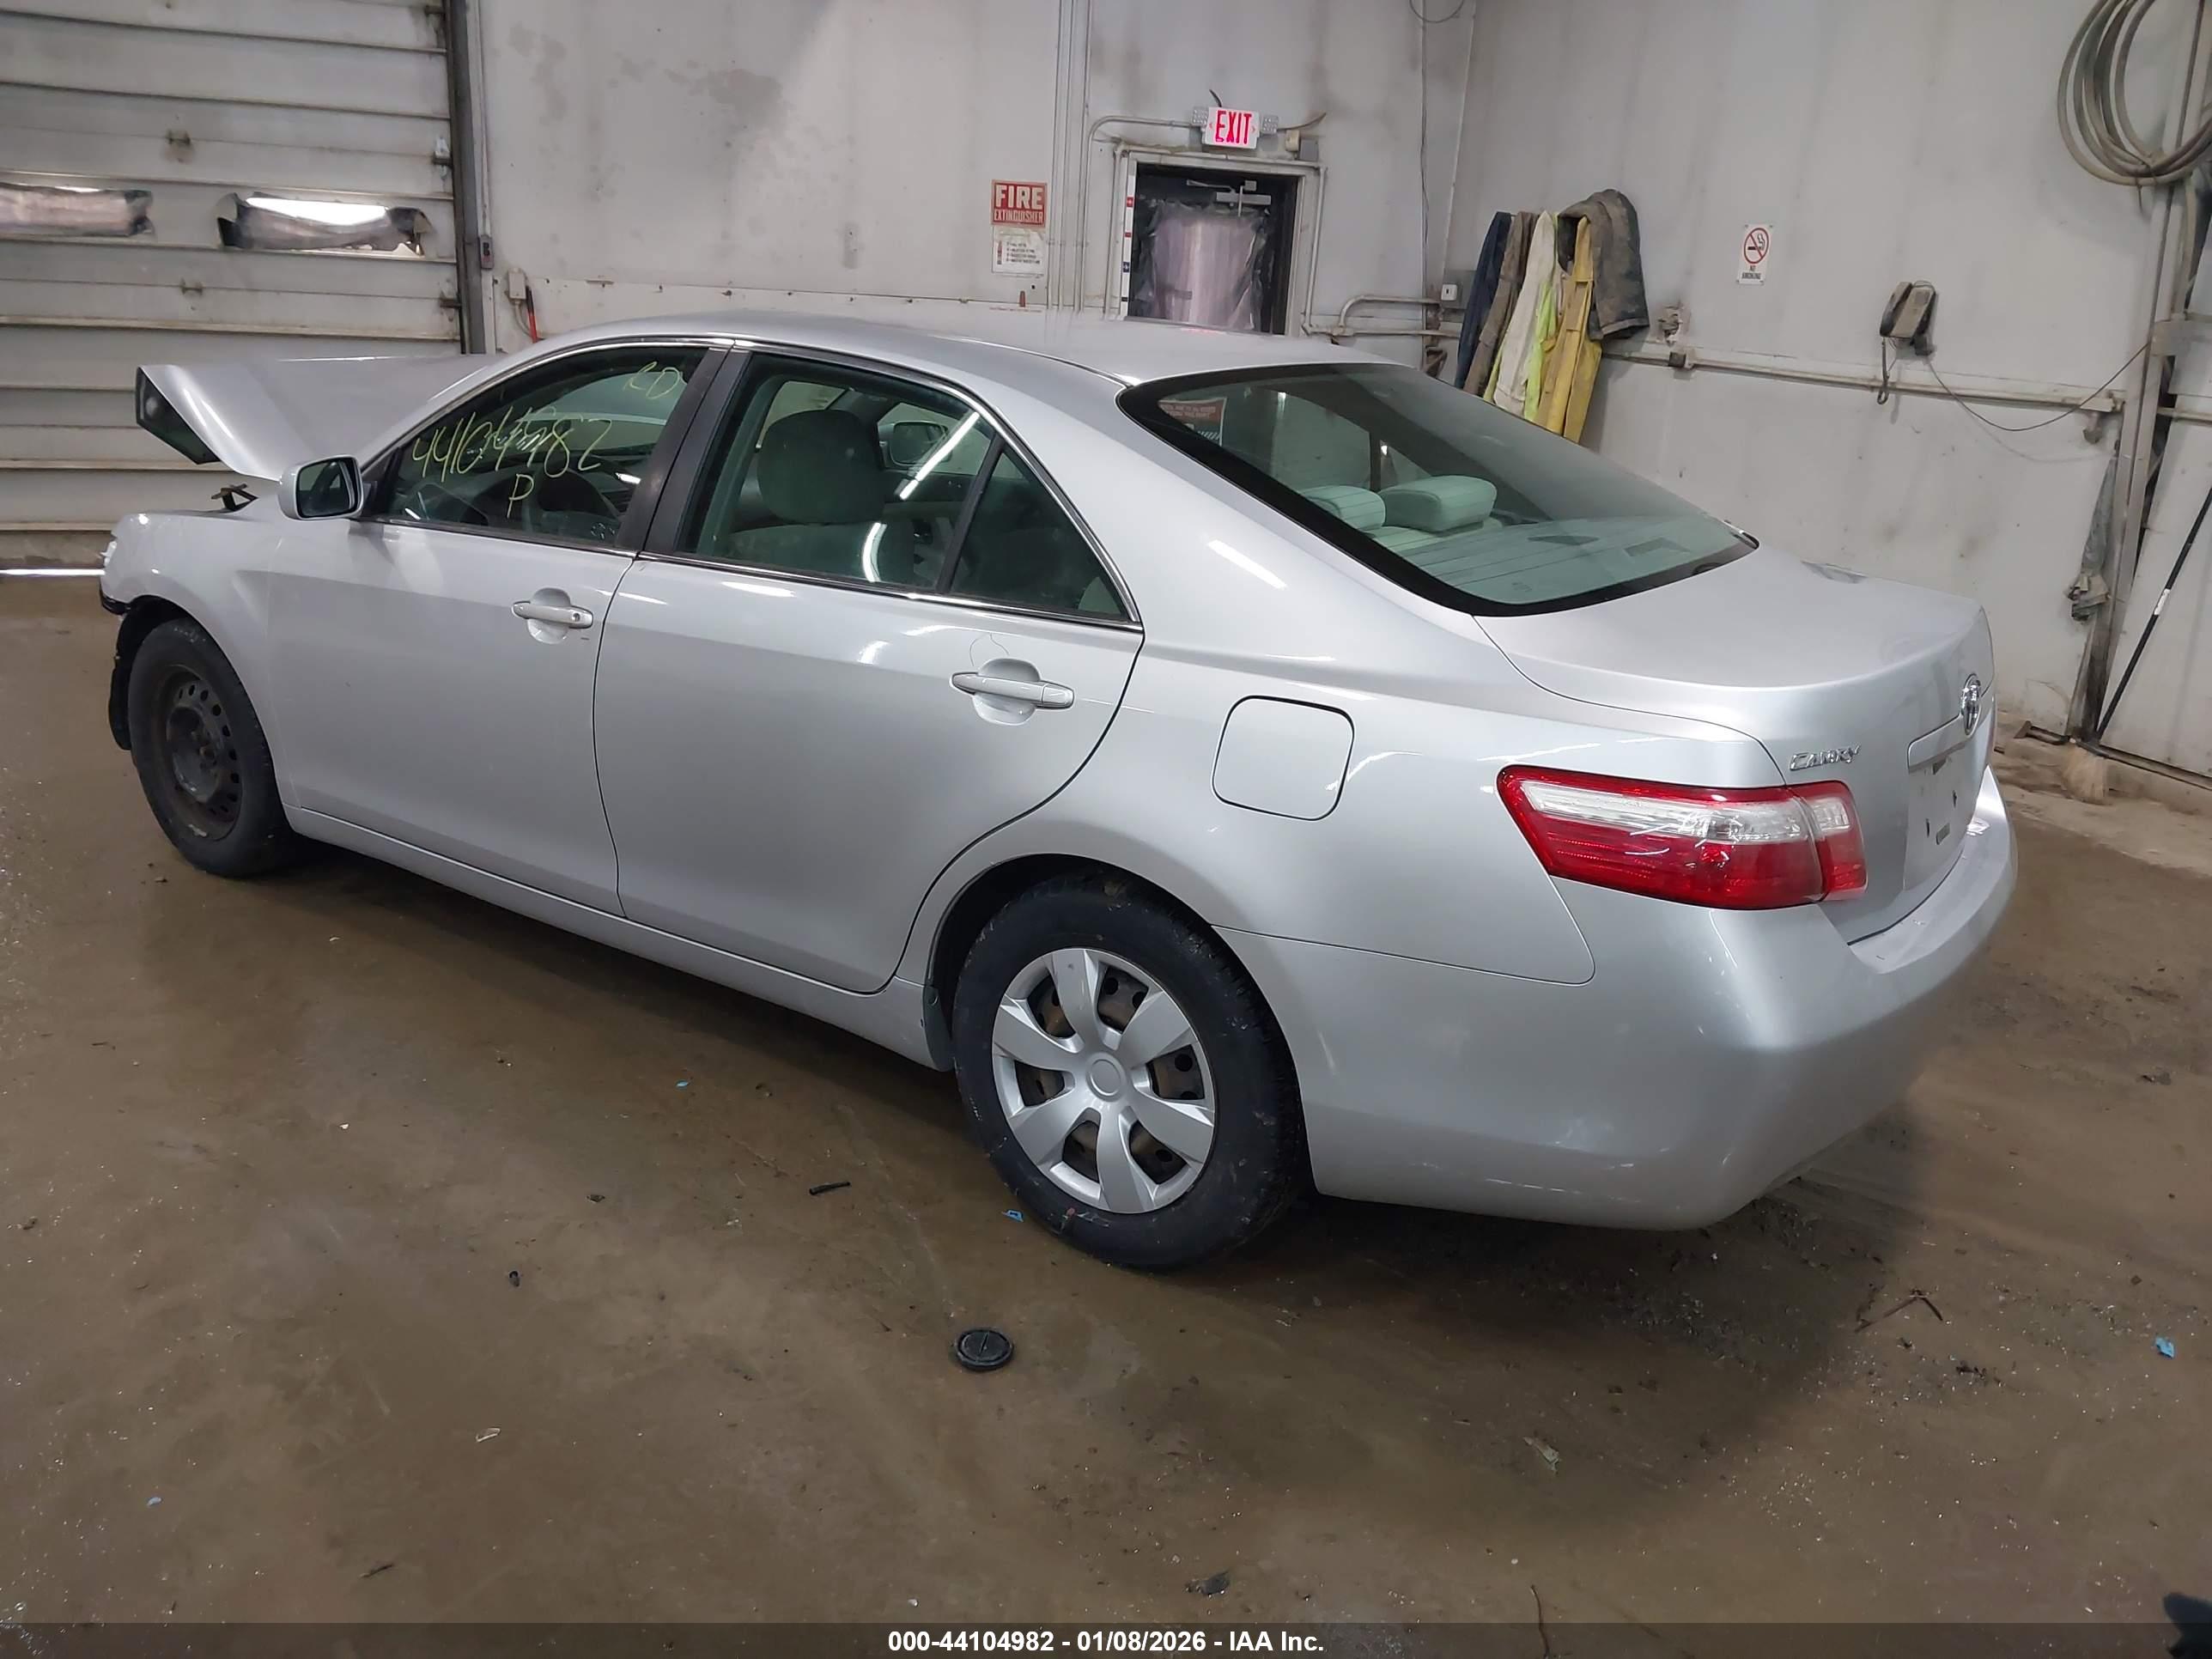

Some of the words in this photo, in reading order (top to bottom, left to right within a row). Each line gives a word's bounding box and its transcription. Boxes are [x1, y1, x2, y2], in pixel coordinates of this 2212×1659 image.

[1215, 110, 1252, 144] EXIT
[995, 184, 1044, 210] FIRE
[994, 208, 1044, 223] EXTINGUISHER
[507, 473, 535, 519] P
